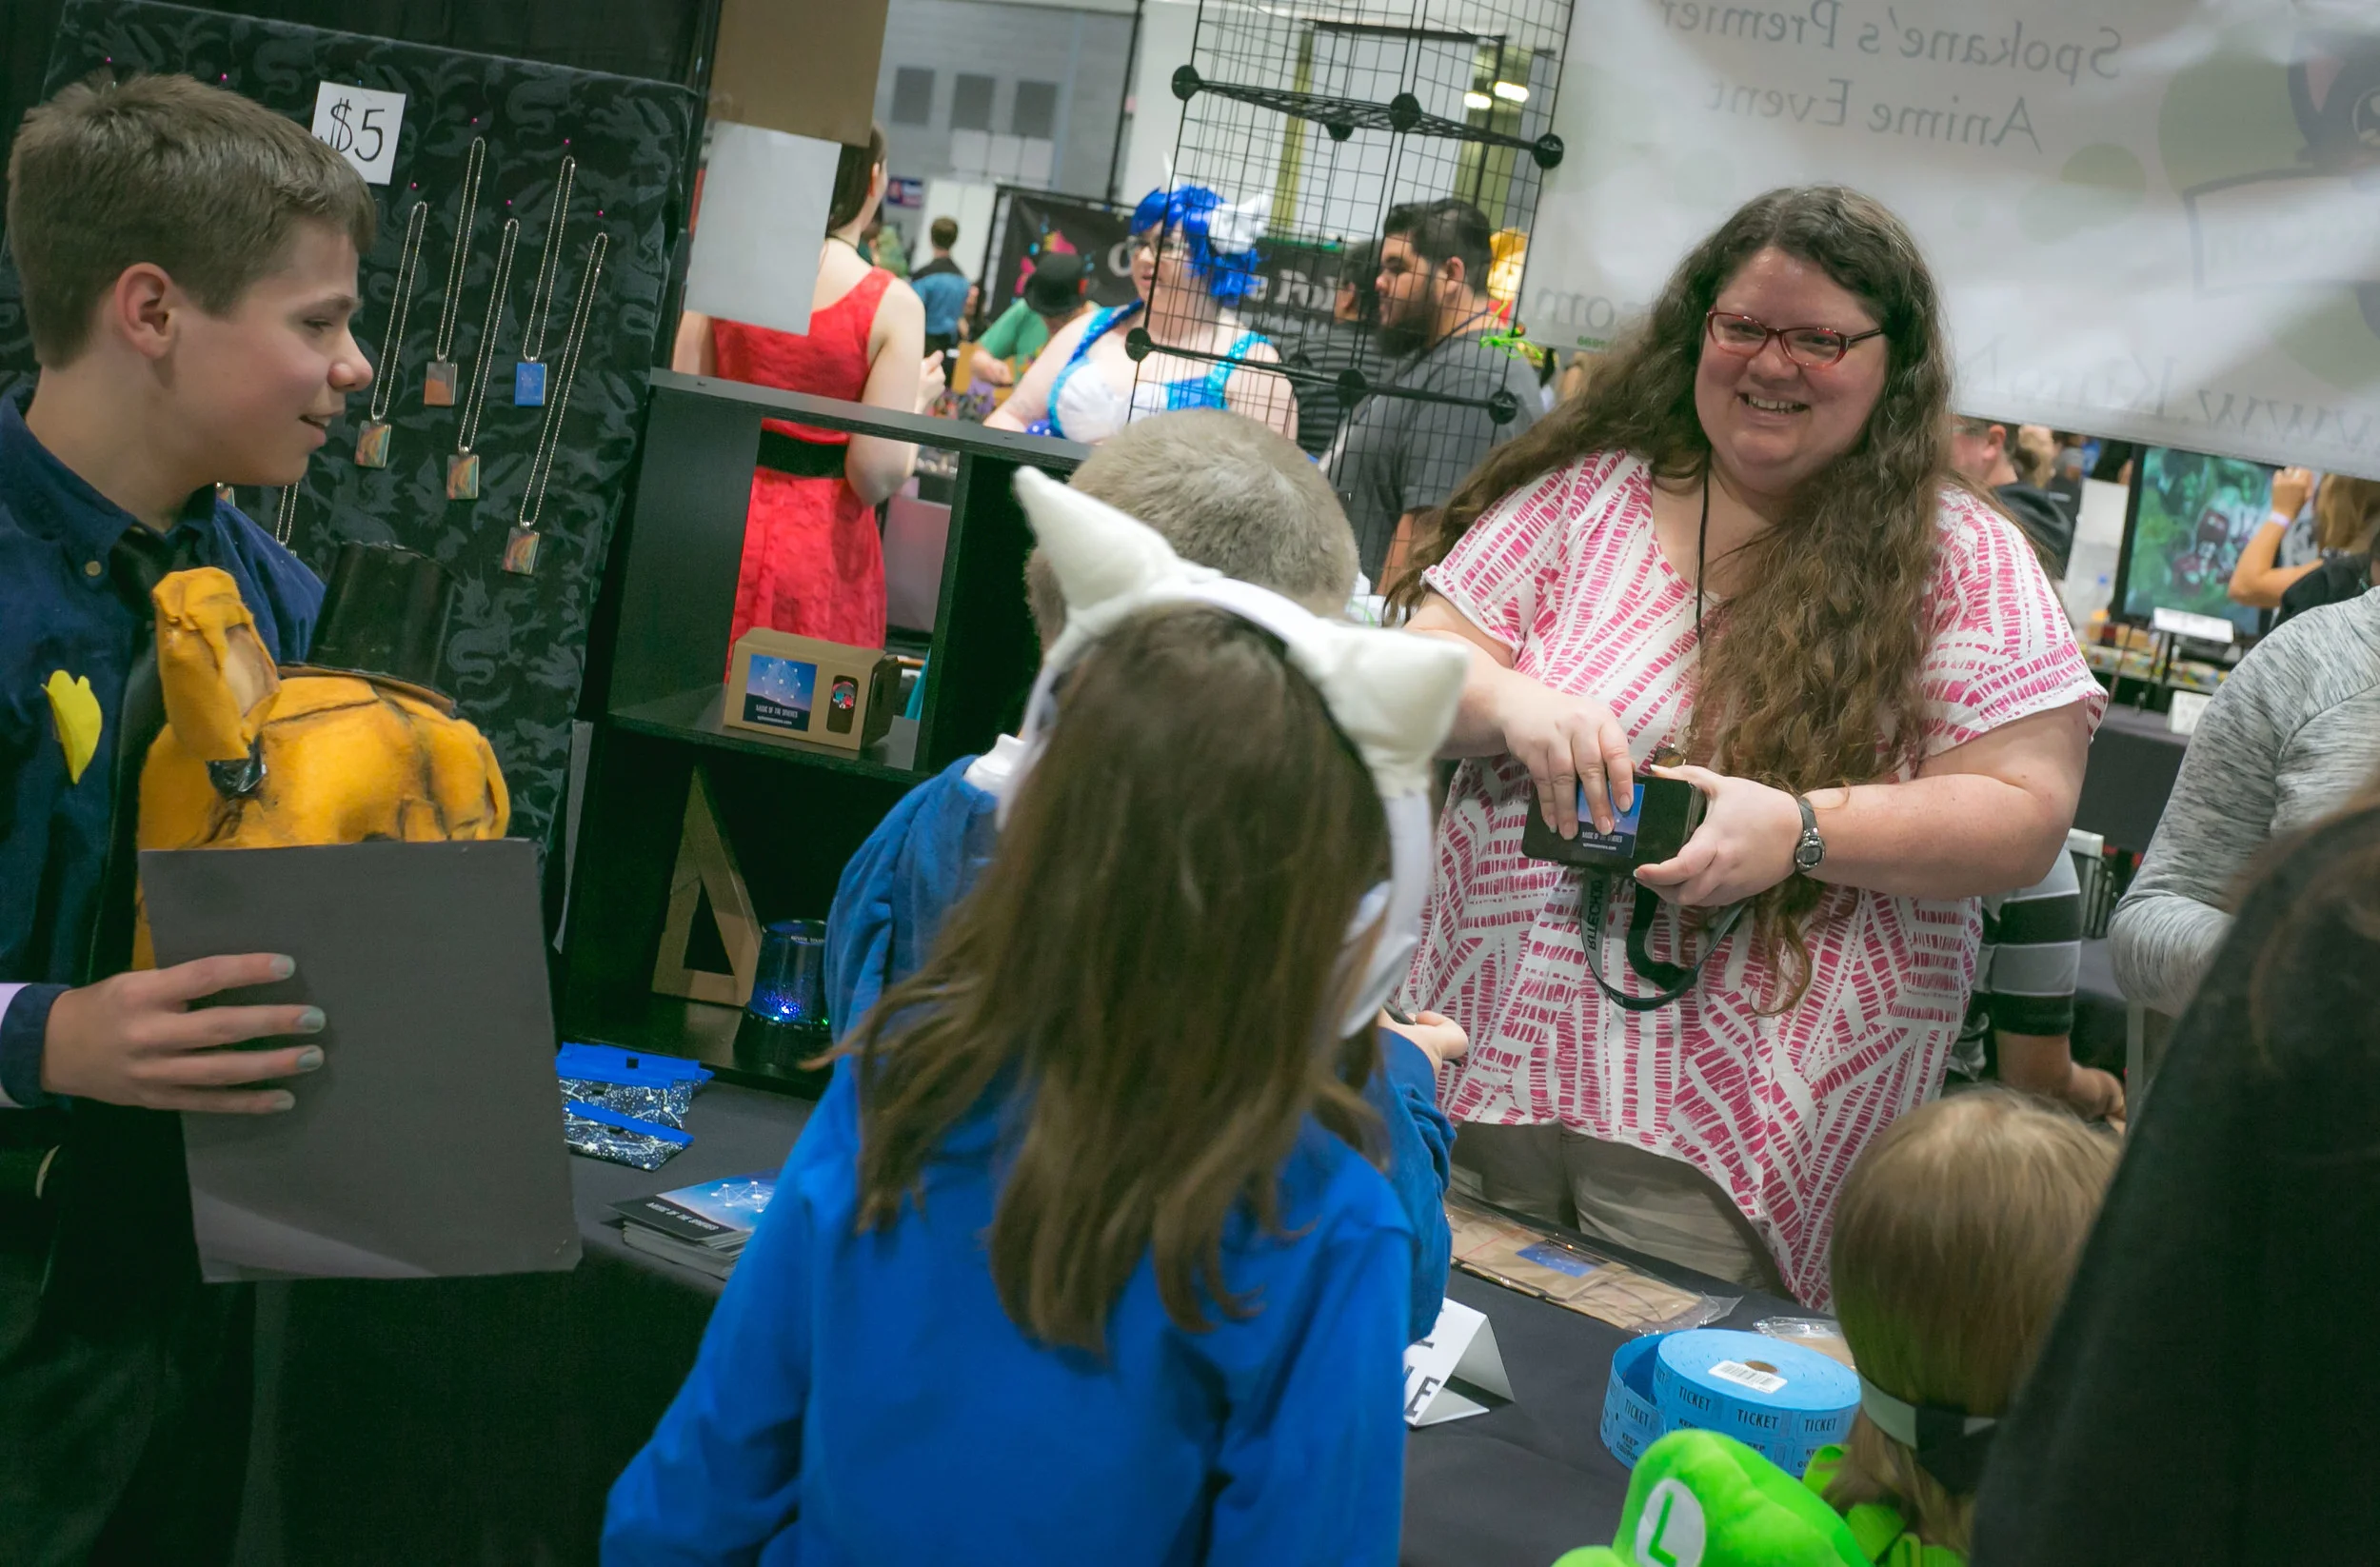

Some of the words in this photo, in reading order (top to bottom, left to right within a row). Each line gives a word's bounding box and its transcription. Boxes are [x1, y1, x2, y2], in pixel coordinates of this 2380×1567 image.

[318, 97, 385, 162] $5
[1625, 1398, 1649, 1427] TICKET
[1679, 1385, 1712, 1412] TICKET
[1736, 1409, 1779, 1430] TICKET
[1805, 1418, 1837, 1433] TICKET
[1648, 1491, 1677, 1567] L
